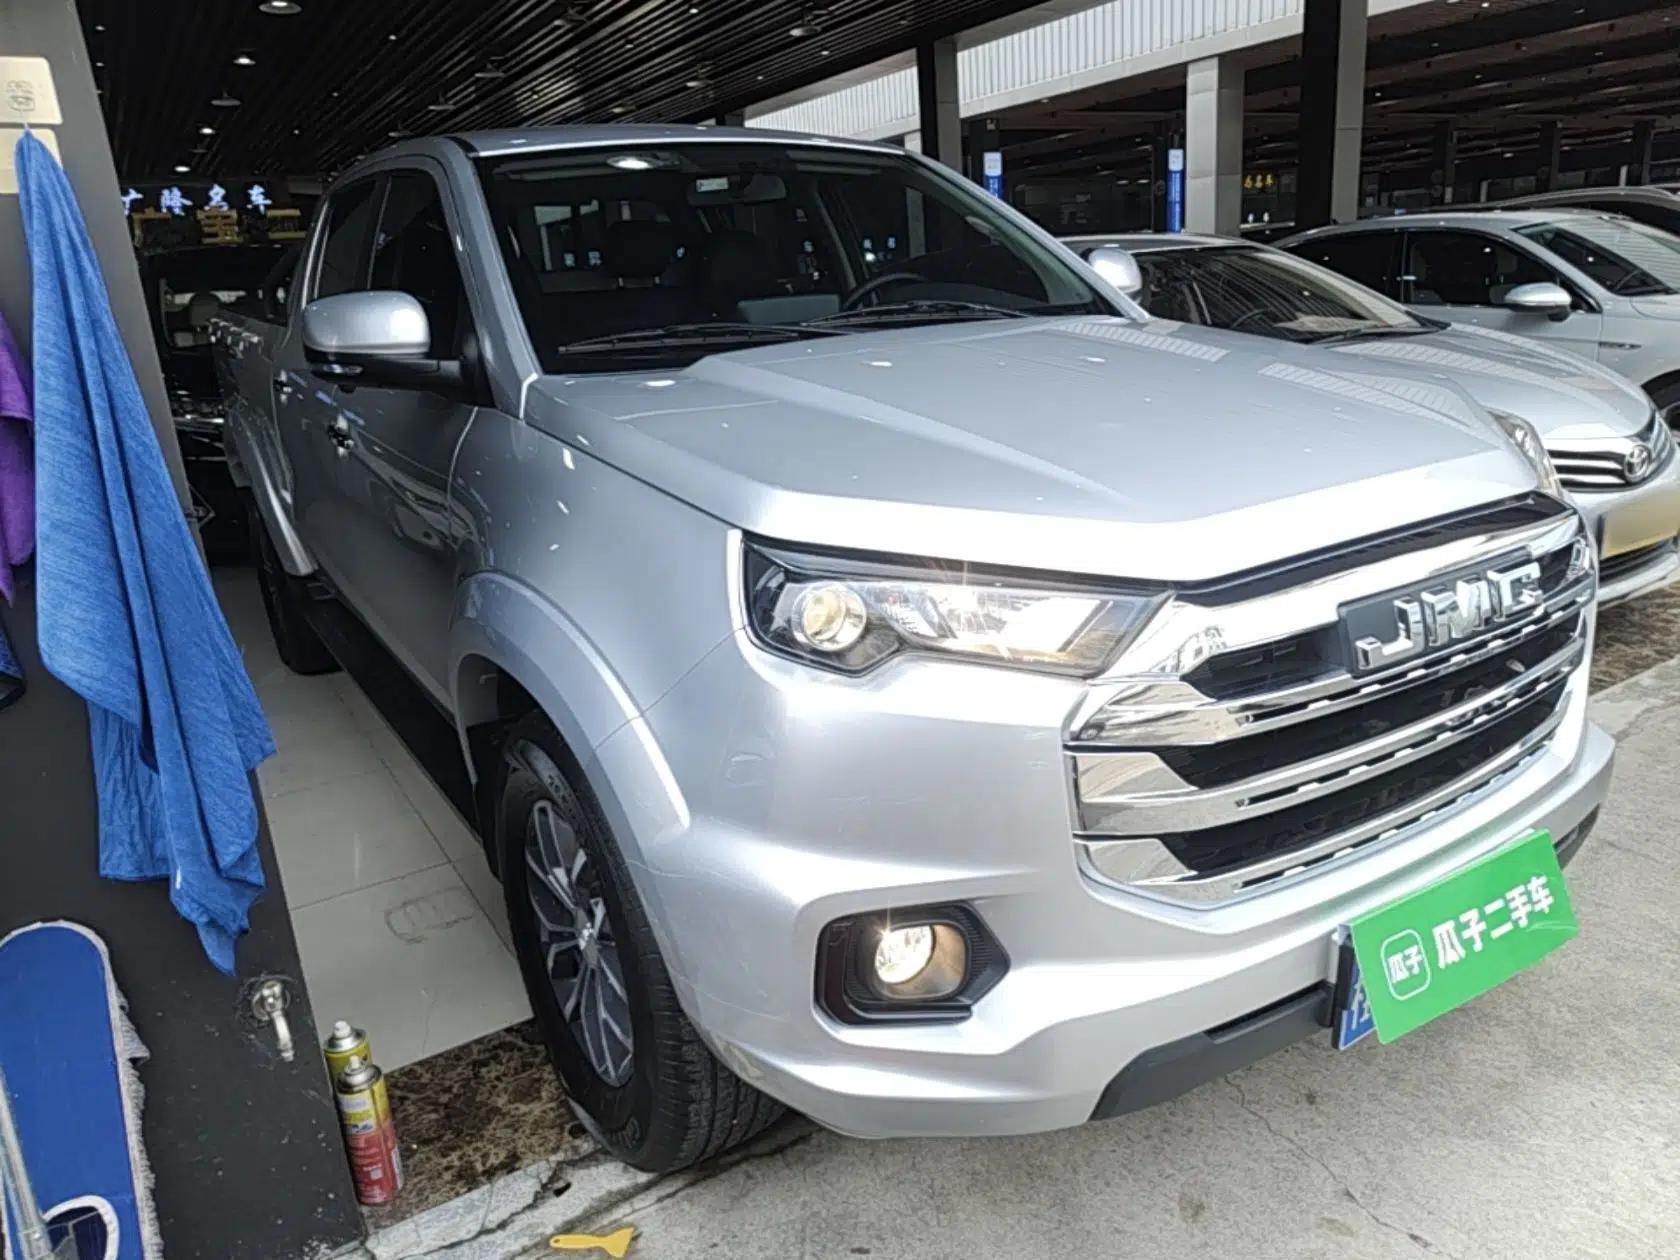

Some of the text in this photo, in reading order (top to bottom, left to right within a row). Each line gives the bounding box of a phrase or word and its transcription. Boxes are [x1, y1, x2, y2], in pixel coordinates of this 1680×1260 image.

[1432, 874, 1555, 969] 瓜子二手车
[1387, 946, 1425, 984] 瓜子
